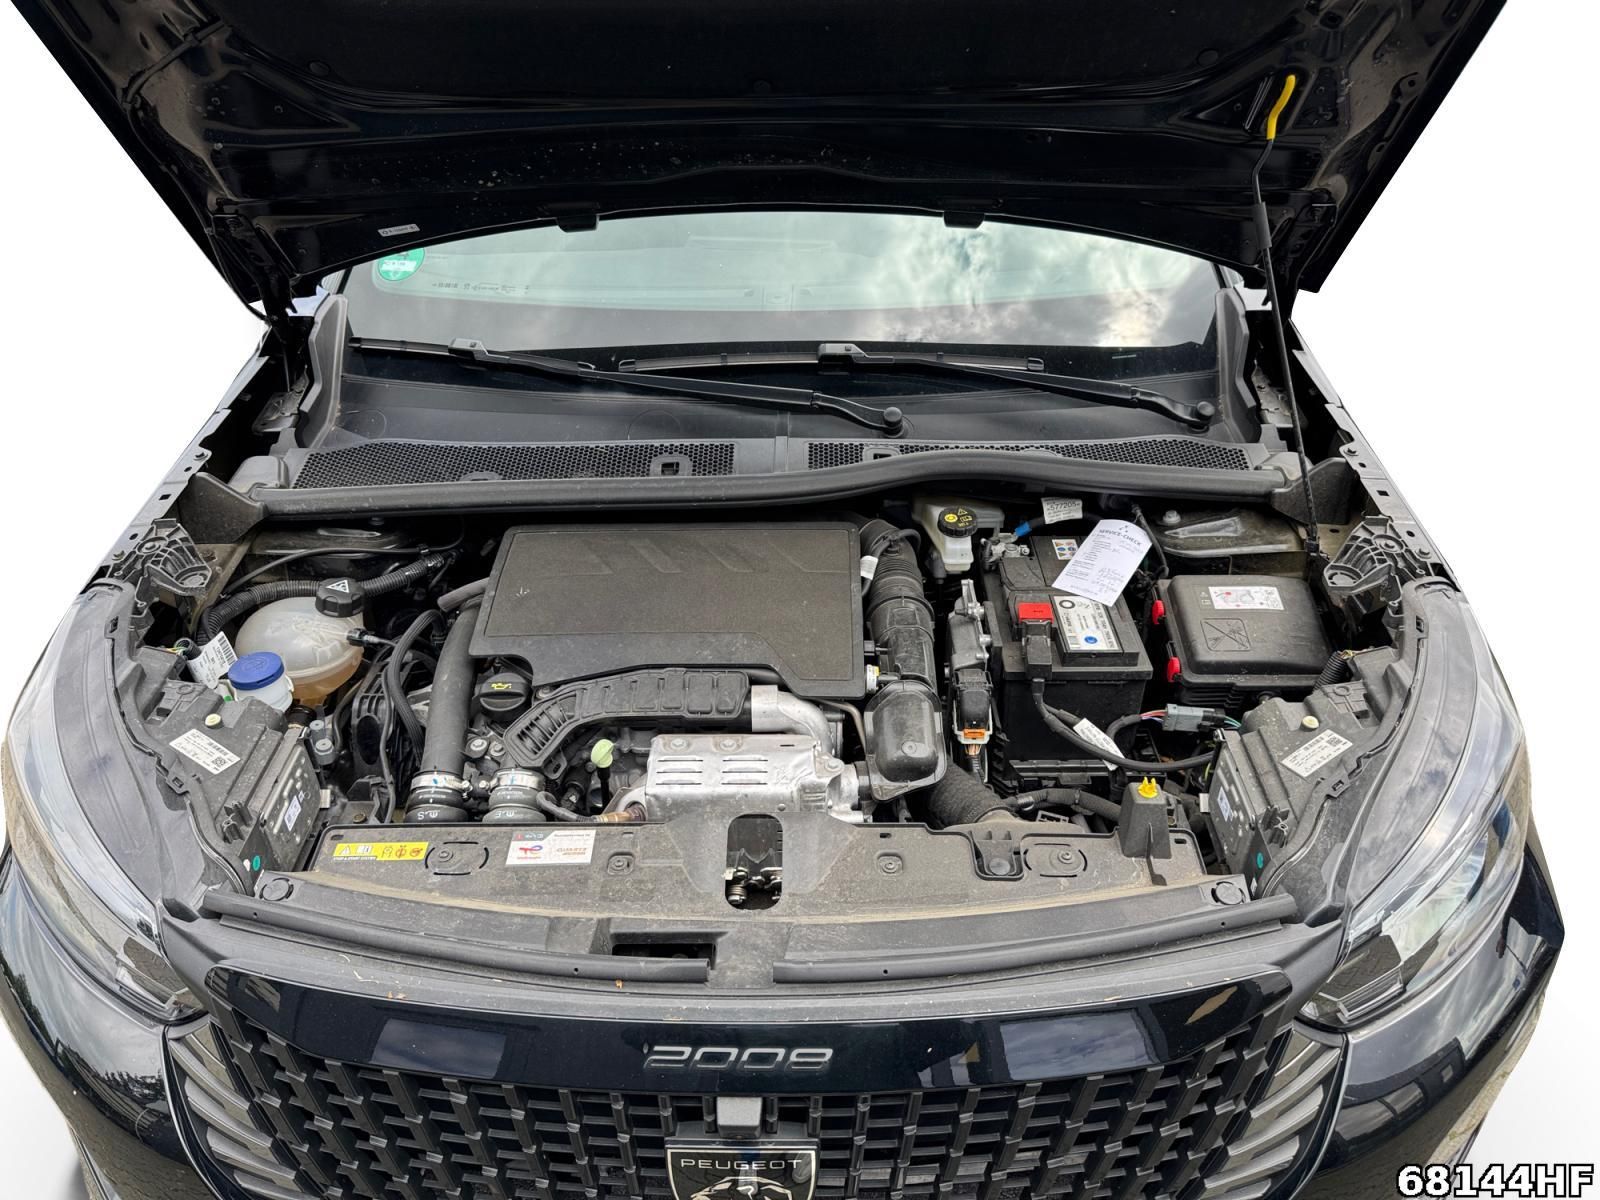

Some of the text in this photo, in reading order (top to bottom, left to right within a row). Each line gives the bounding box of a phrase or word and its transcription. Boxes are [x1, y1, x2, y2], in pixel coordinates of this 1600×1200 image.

[1099, 528, 1142, 546] SERVICE-CHECK
[644, 1045, 834, 1071] 2008
[680, 1158, 803, 1170] PEUGEOT
